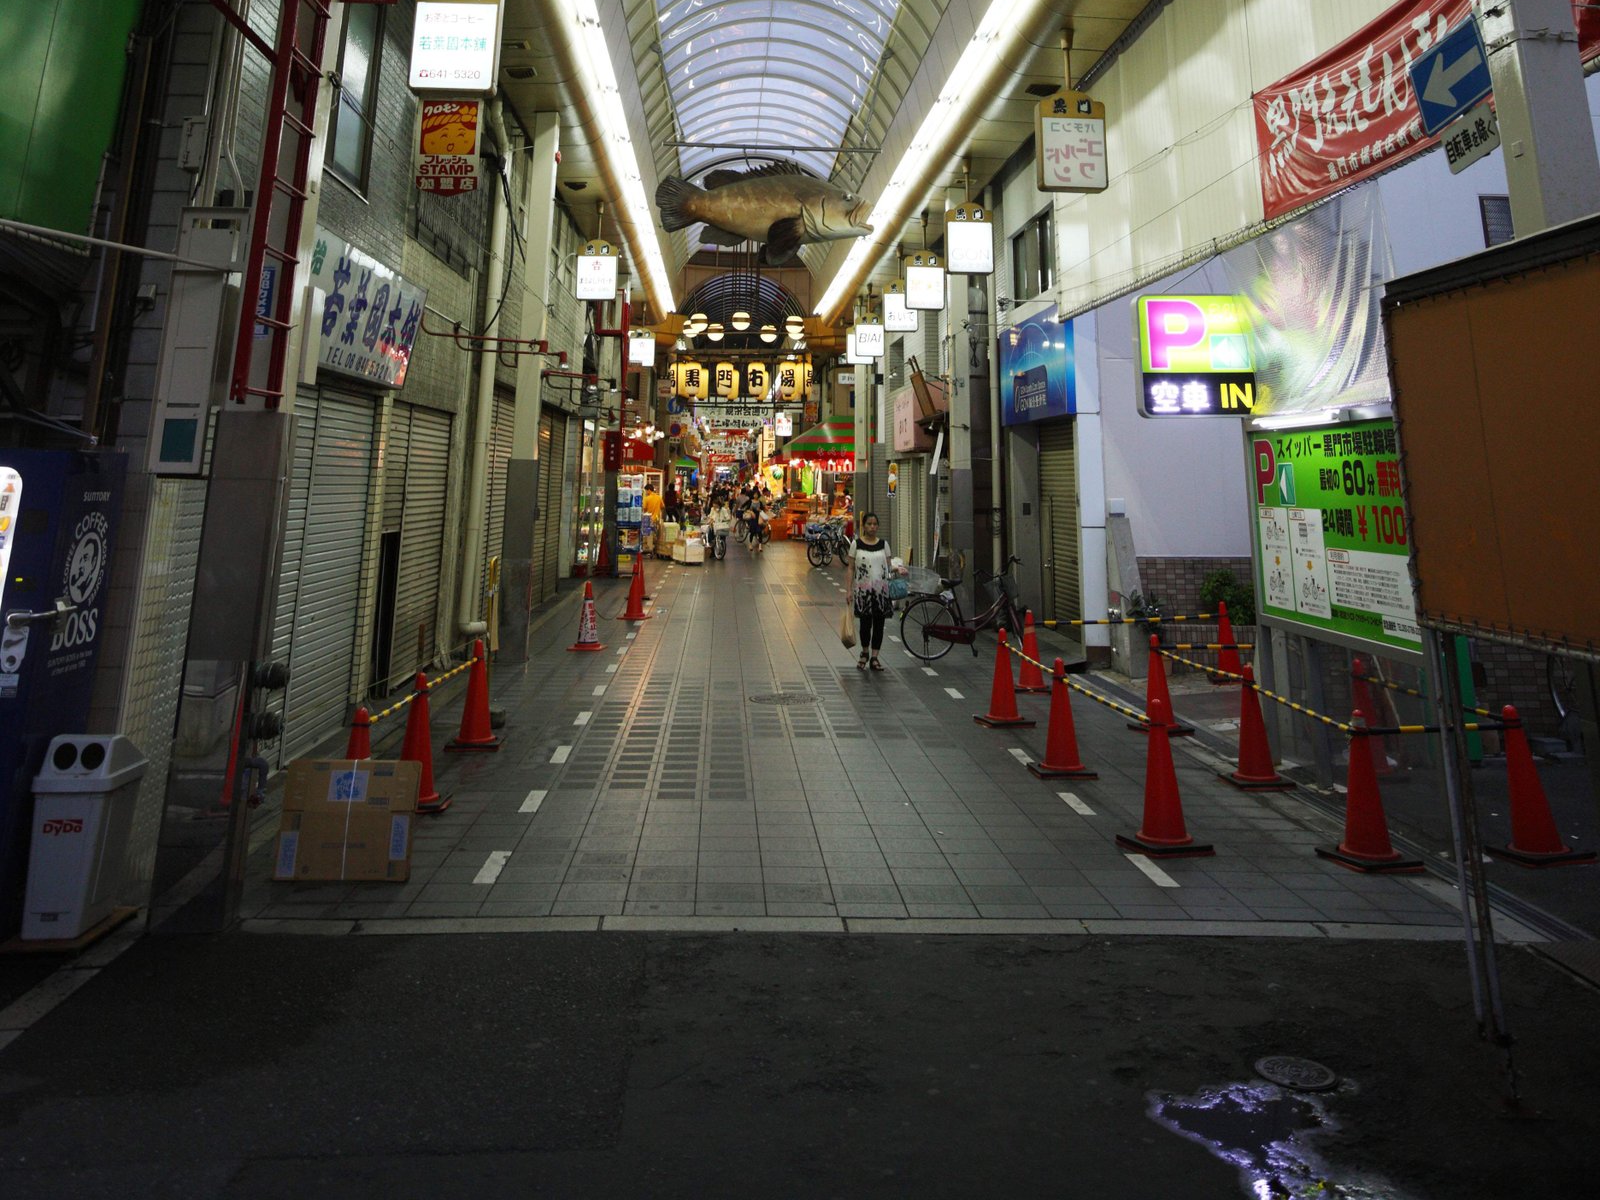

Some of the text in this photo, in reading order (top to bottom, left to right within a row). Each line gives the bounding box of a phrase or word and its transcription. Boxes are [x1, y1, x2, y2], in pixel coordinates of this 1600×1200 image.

[424, 102, 461, 115] クロモン
[1053, 98, 1093, 114] 黒門
[1445, 118, 1496, 165] 自転車を除く
[419, 164, 475, 176] STAMP
[424, 155, 469, 165] フレッシュ
[419, 176, 475, 191] 加盟店
[1147, 299, 1207, 369] P
[325, 346, 344, 366] TEL
[684, 367, 795, 388] 黒門市場
[1150, 381, 1254, 413] 空車 IN
[1254, 439, 1275, 505] P
[75, 511, 109, 541] COFFEE
[42, 818, 84, 835] DyDo
